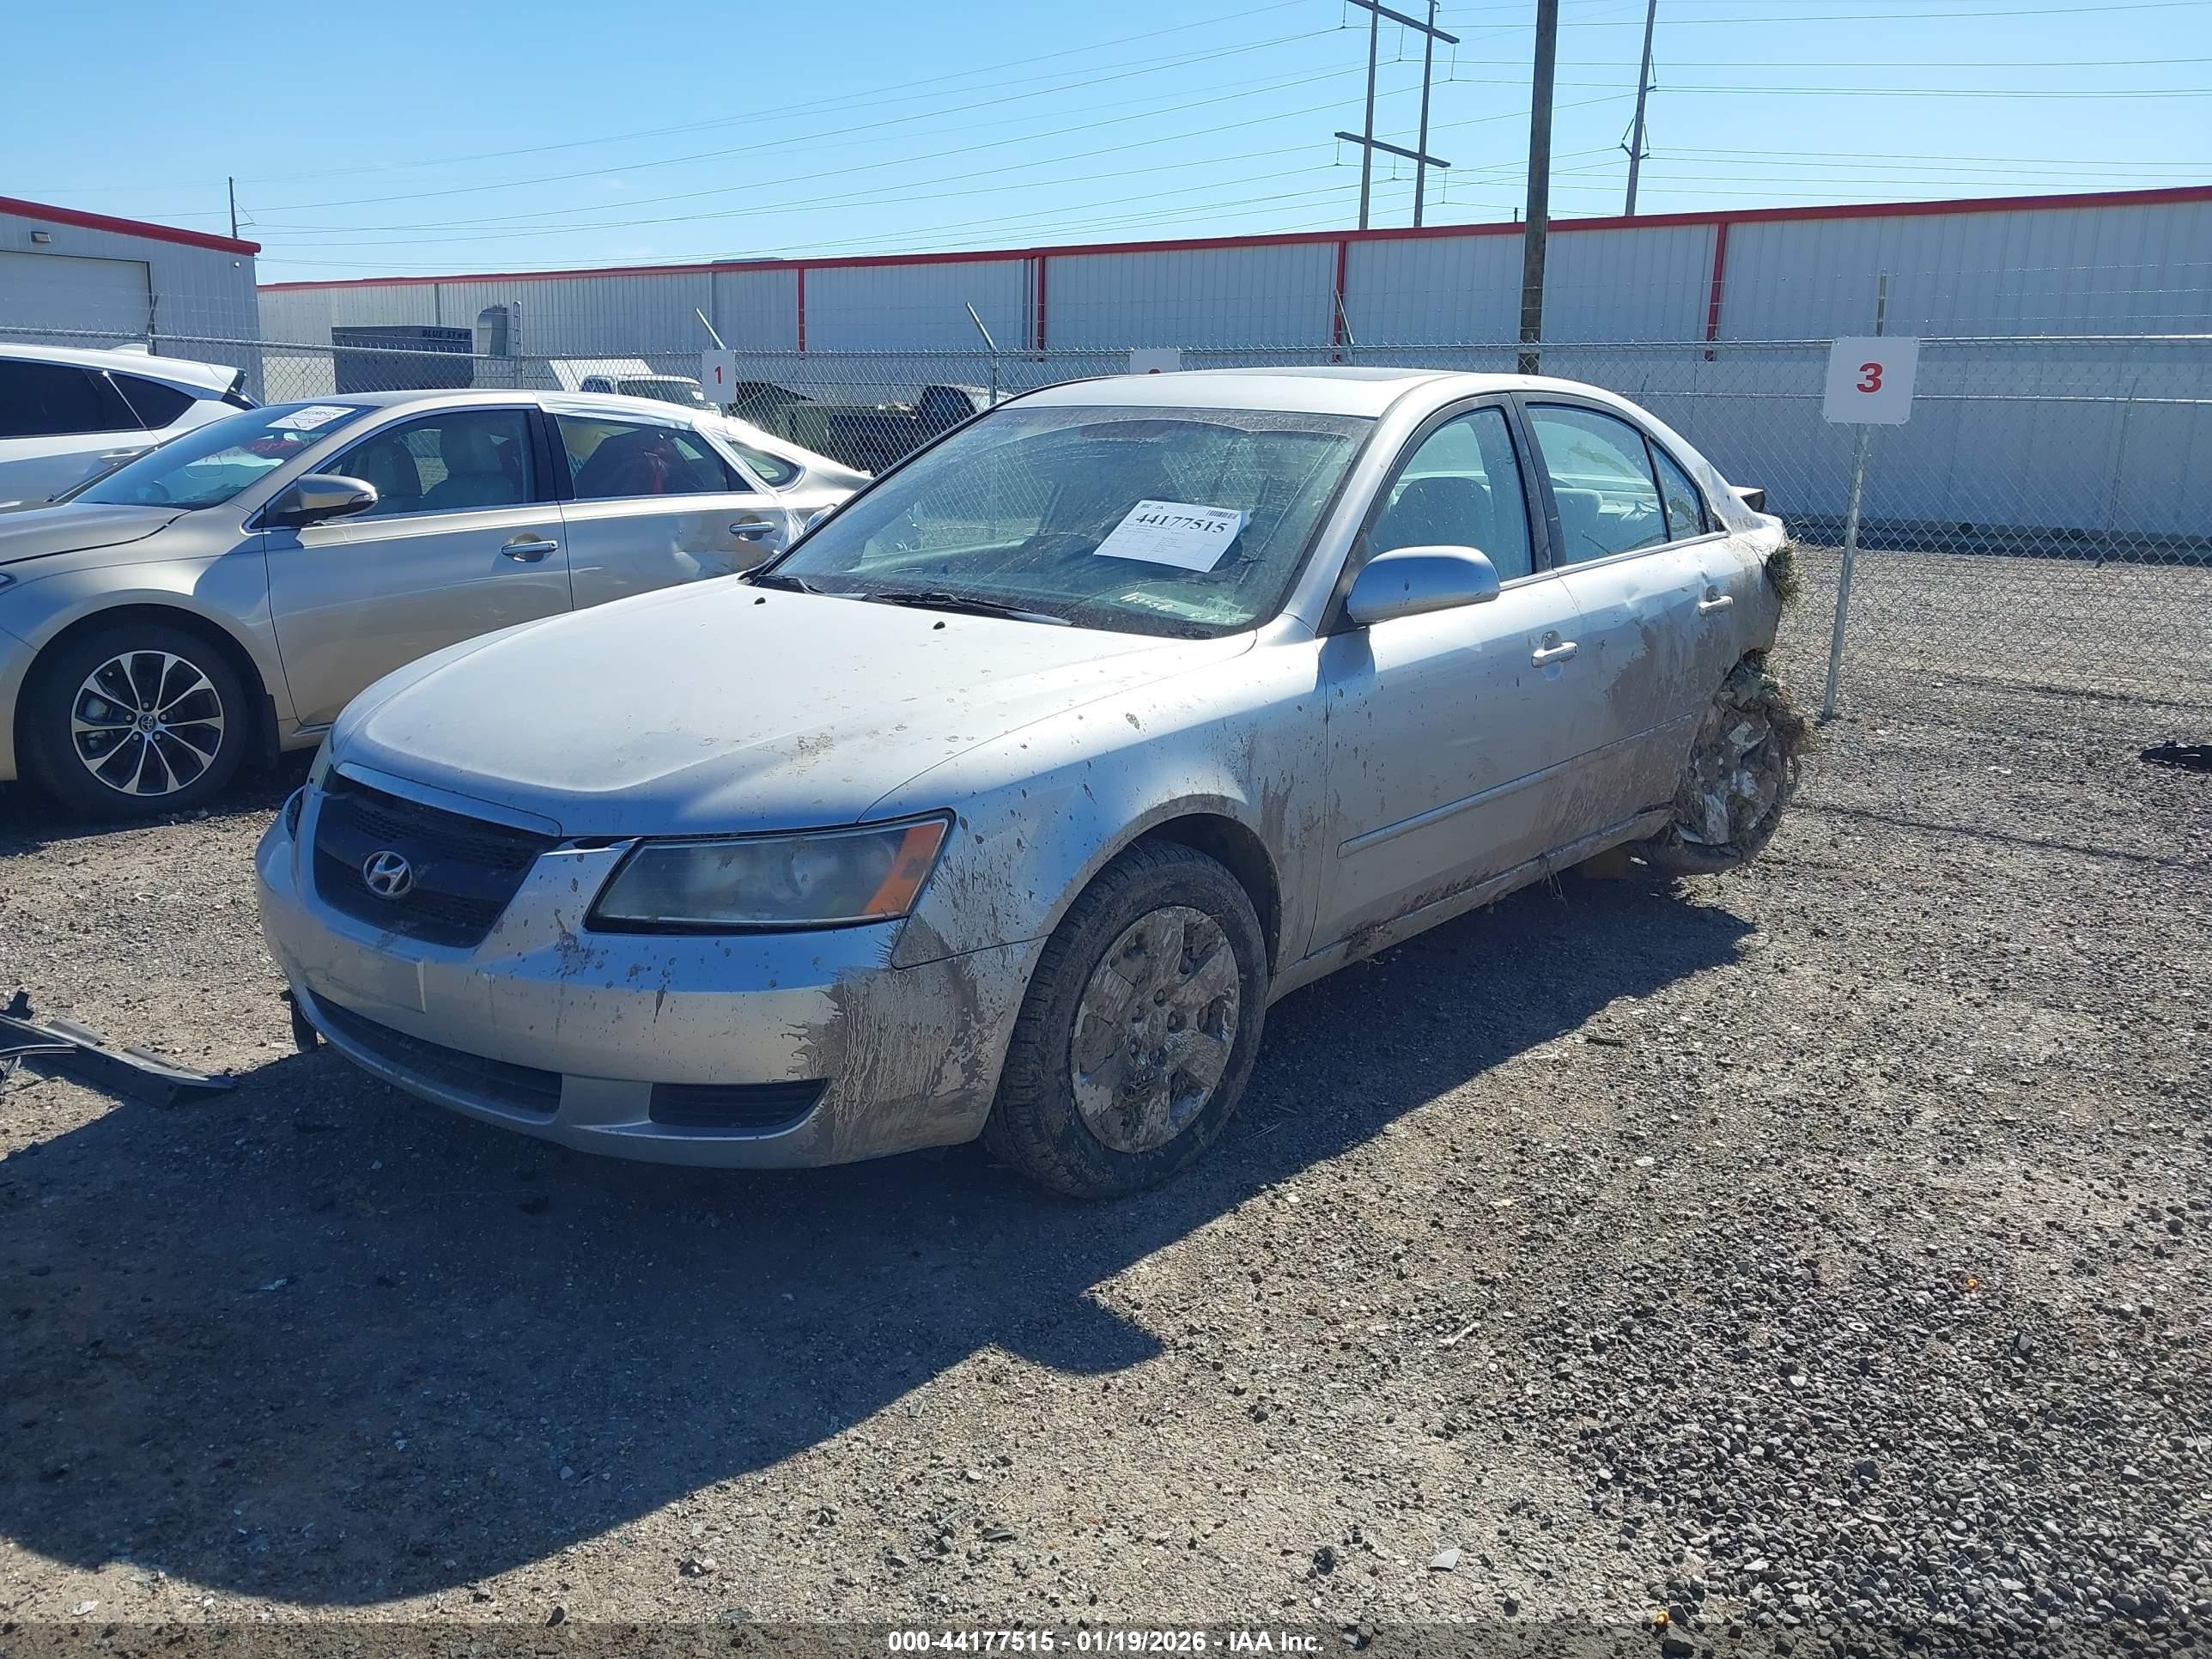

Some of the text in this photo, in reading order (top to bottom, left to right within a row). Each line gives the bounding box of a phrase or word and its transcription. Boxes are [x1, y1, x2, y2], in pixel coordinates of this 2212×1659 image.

[422, 329, 443, 338] BLUE
[714, 366, 722, 385] 1
[1856, 362, 1884, 393] 3
[1134, 513, 1230, 534] 44177515
